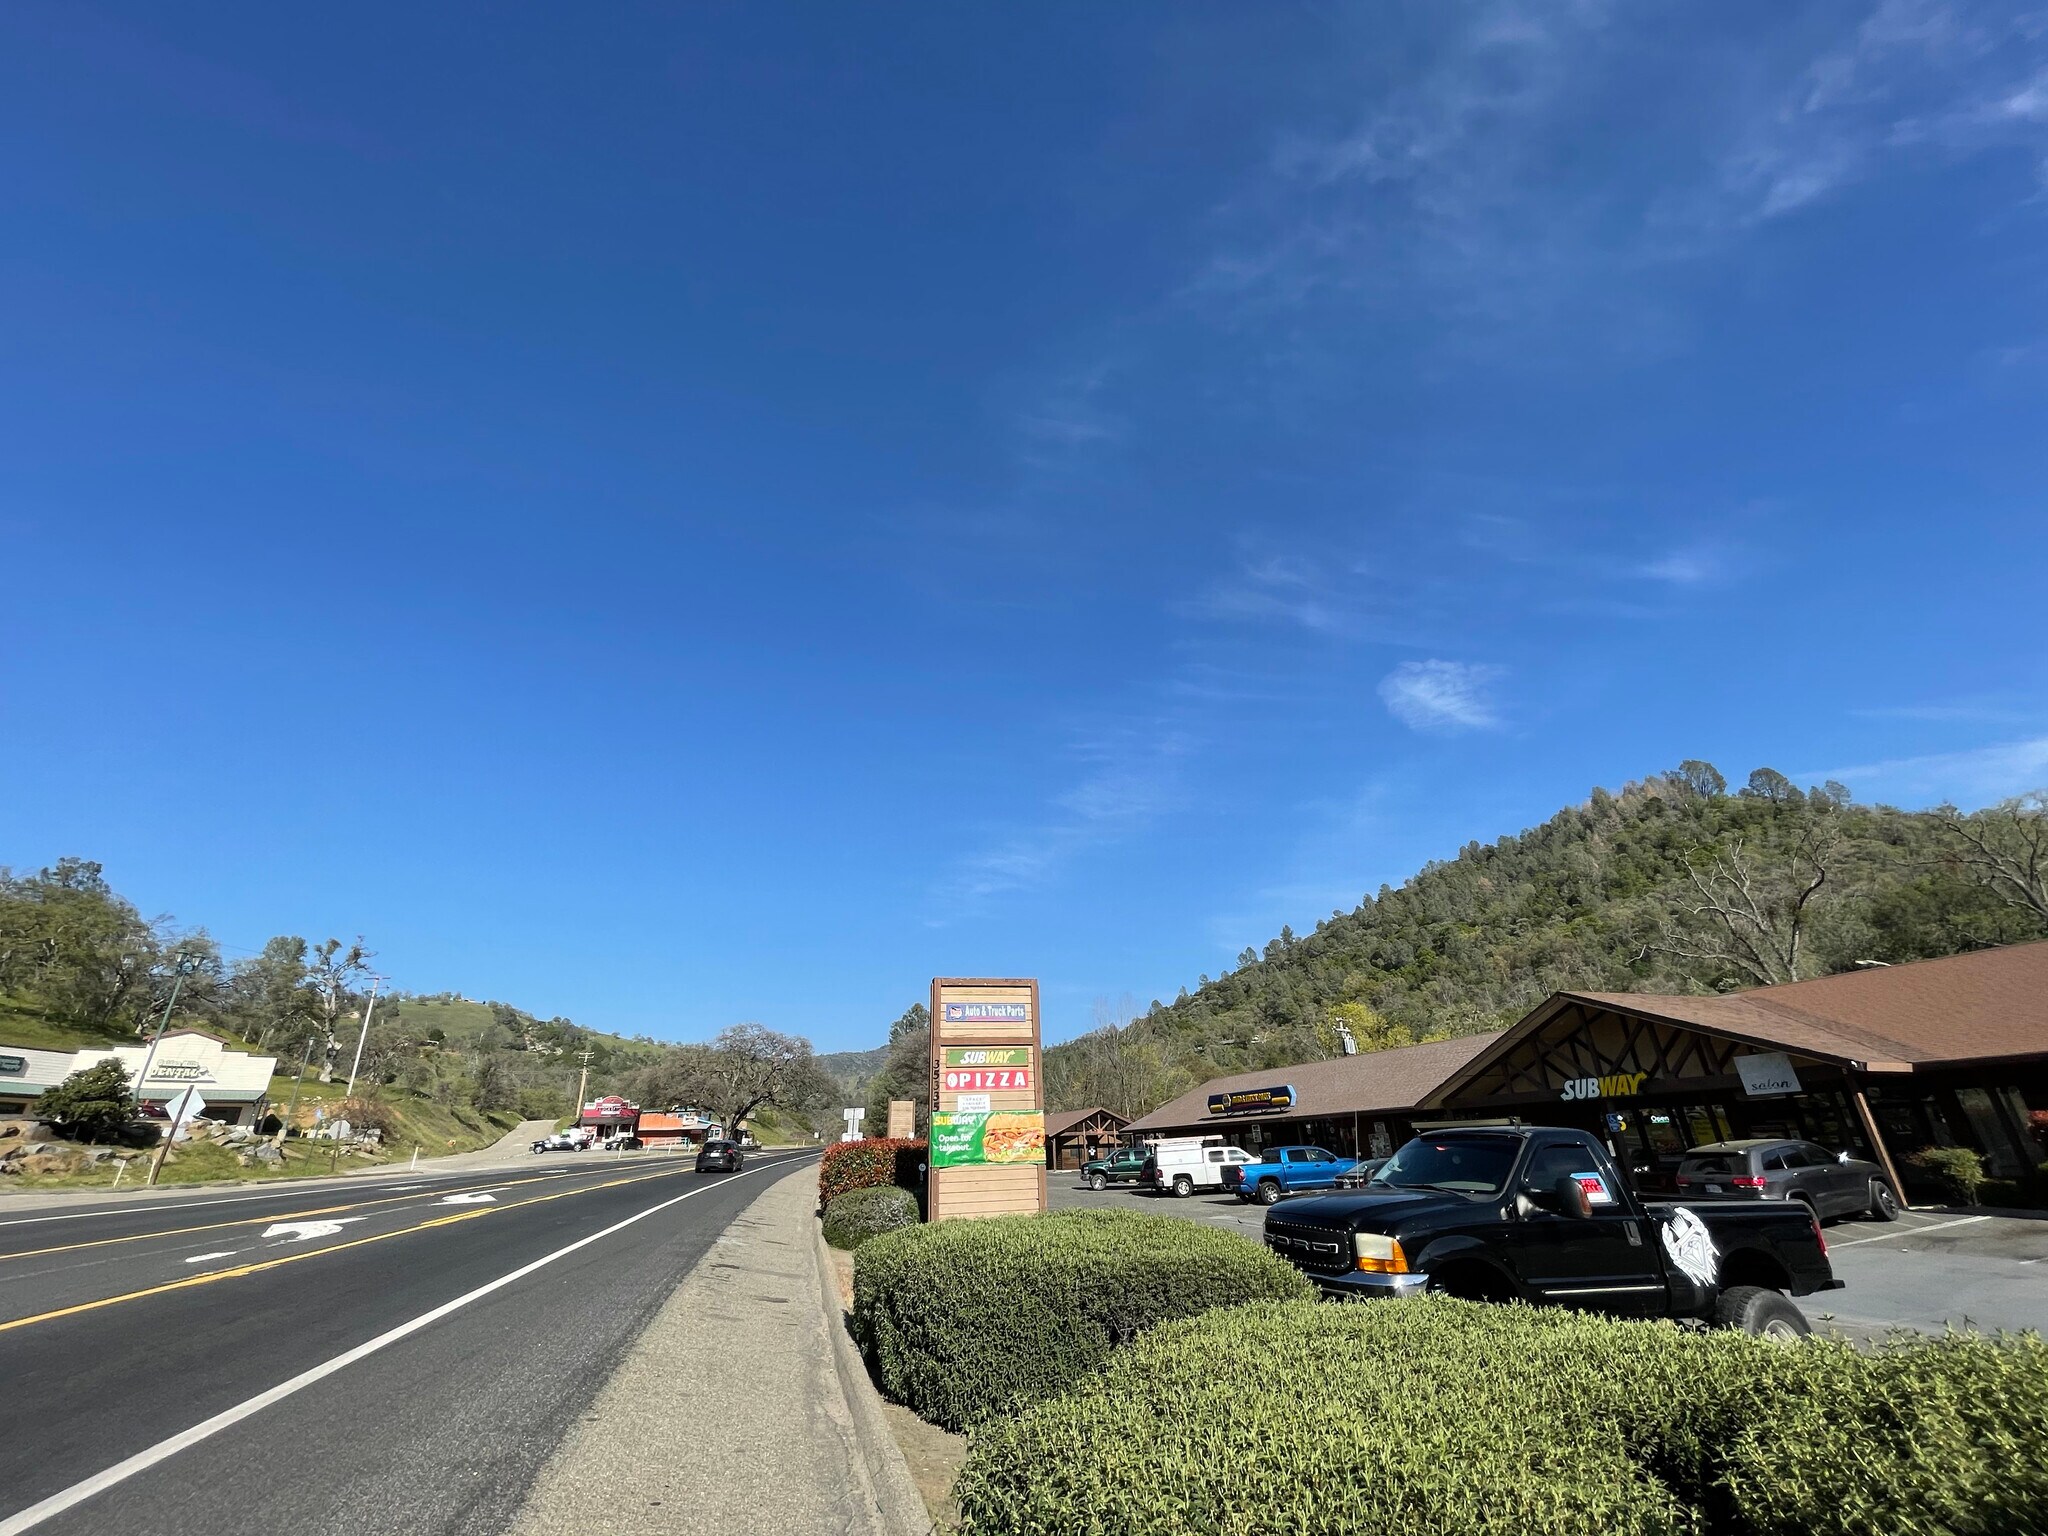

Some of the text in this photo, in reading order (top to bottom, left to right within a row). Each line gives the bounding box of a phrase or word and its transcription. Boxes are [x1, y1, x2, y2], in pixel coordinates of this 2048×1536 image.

[965, 1005, 981, 1017] Auto
[981, 1005, 987, 1016] &
[987, 1005, 1006, 1017] Truck
[1006, 1005, 1025, 1016] Parts
[960, 1050, 1015, 1064] SUBWAY
[150, 1068, 200, 1078] DENTAL
[1560, 1070, 1647, 1102] SUBWAY
[1751, 1079, 1792, 1091] salon
[933, 1115, 977, 1126] SUBWAY
[1650, 1115, 1671, 1124] Open
[938, 1134, 959, 1143] Open
